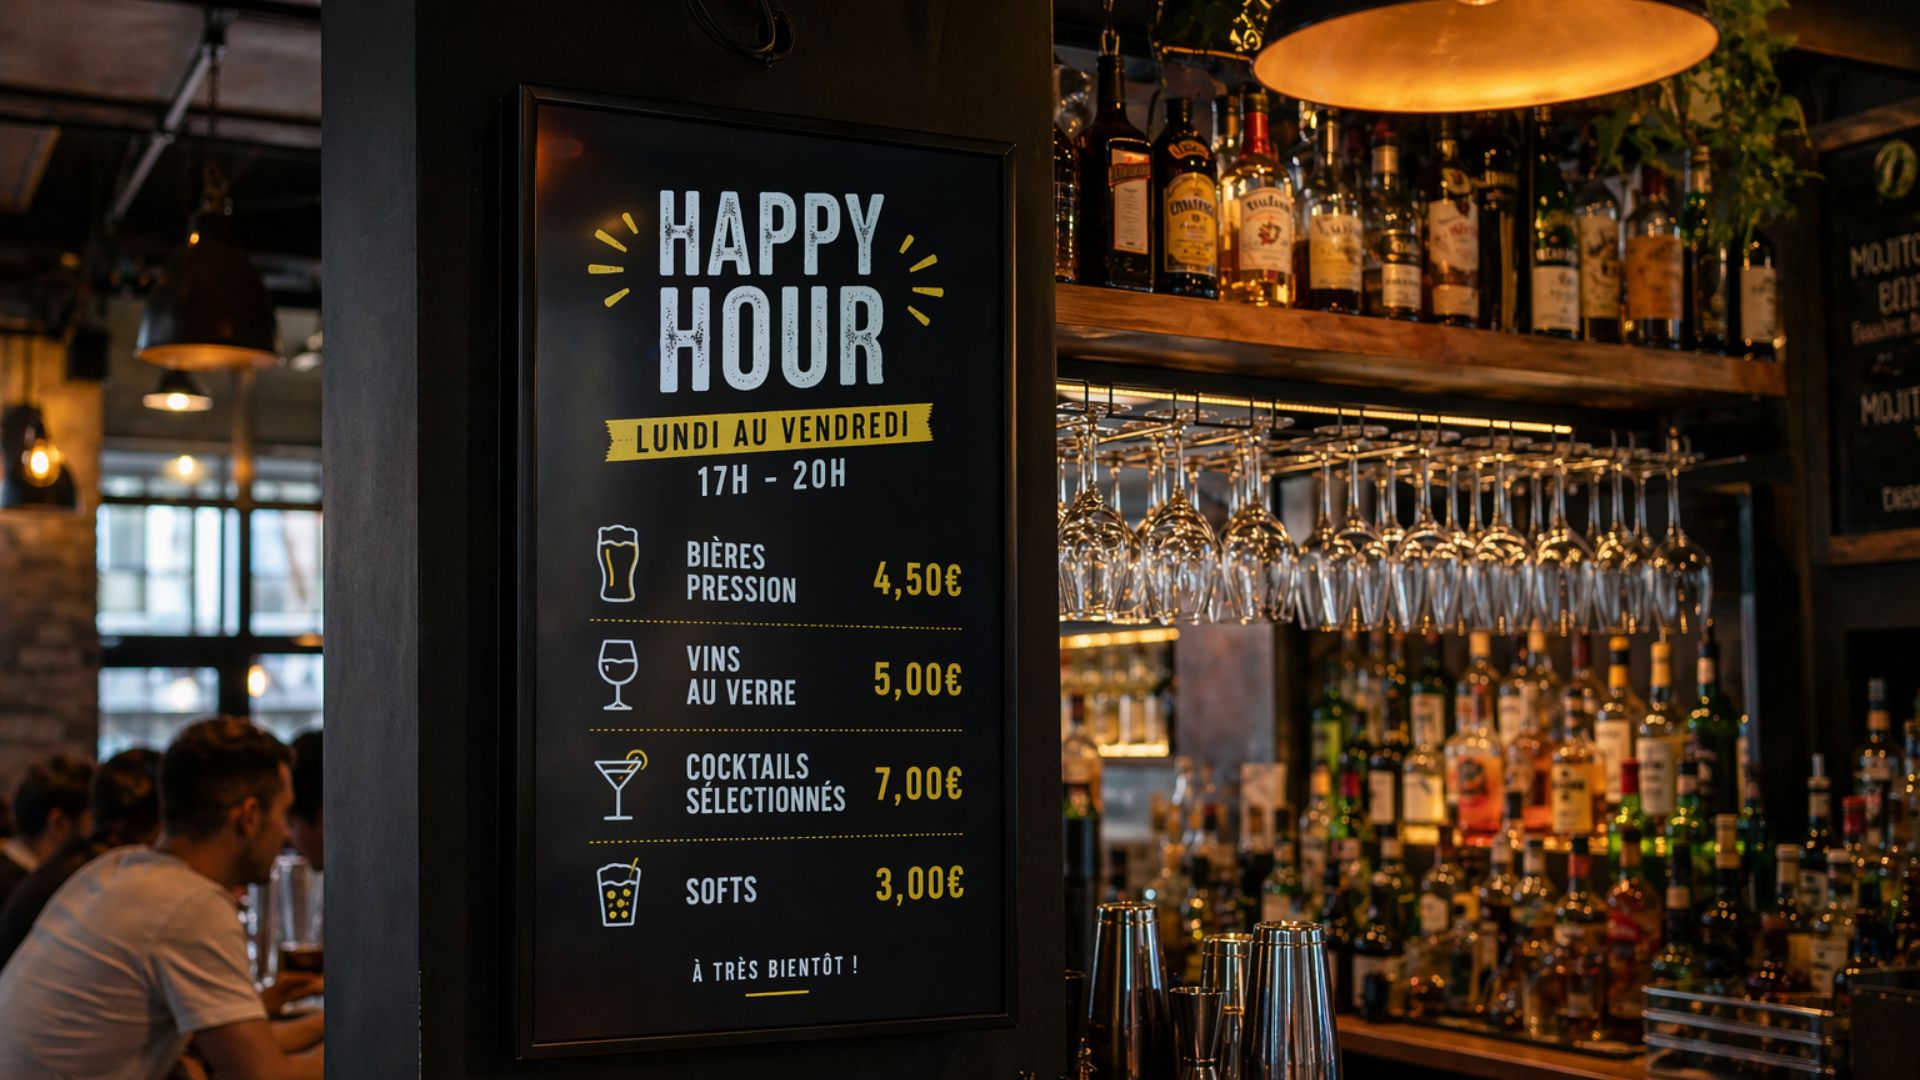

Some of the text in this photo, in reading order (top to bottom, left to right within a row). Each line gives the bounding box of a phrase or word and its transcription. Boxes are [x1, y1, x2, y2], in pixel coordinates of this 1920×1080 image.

[660, 190, 884, 276] HAPPY
[660, 286, 884, 393] HOUR
[637, 411, 908, 453] LUNDI AU VENDREDI
[698, 464, 747, 496] 17H
[794, 458, 845, 490] 20H
[688, 536, 765, 569] BIÈRES
[687, 574, 796, 603] PRESSION
[874, 562, 961, 600] 4,50€
[687, 645, 740, 672] VINS
[687, 679, 795, 705] AU VERRE
[875, 662, 961, 700] 5,00€
[687, 753, 808, 780] COCKTAILS
[687, 778, 845, 814] SÉLECTIONNÉS
[875, 767, 962, 805] 7,00€
[686, 876, 756, 905] SOFTS
[876, 865, 963, 906] 3,00€
[693, 959, 702, 982] À
[713, 957, 757, 981] TRÈS
[769, 953, 843, 978] BIENTÔT
